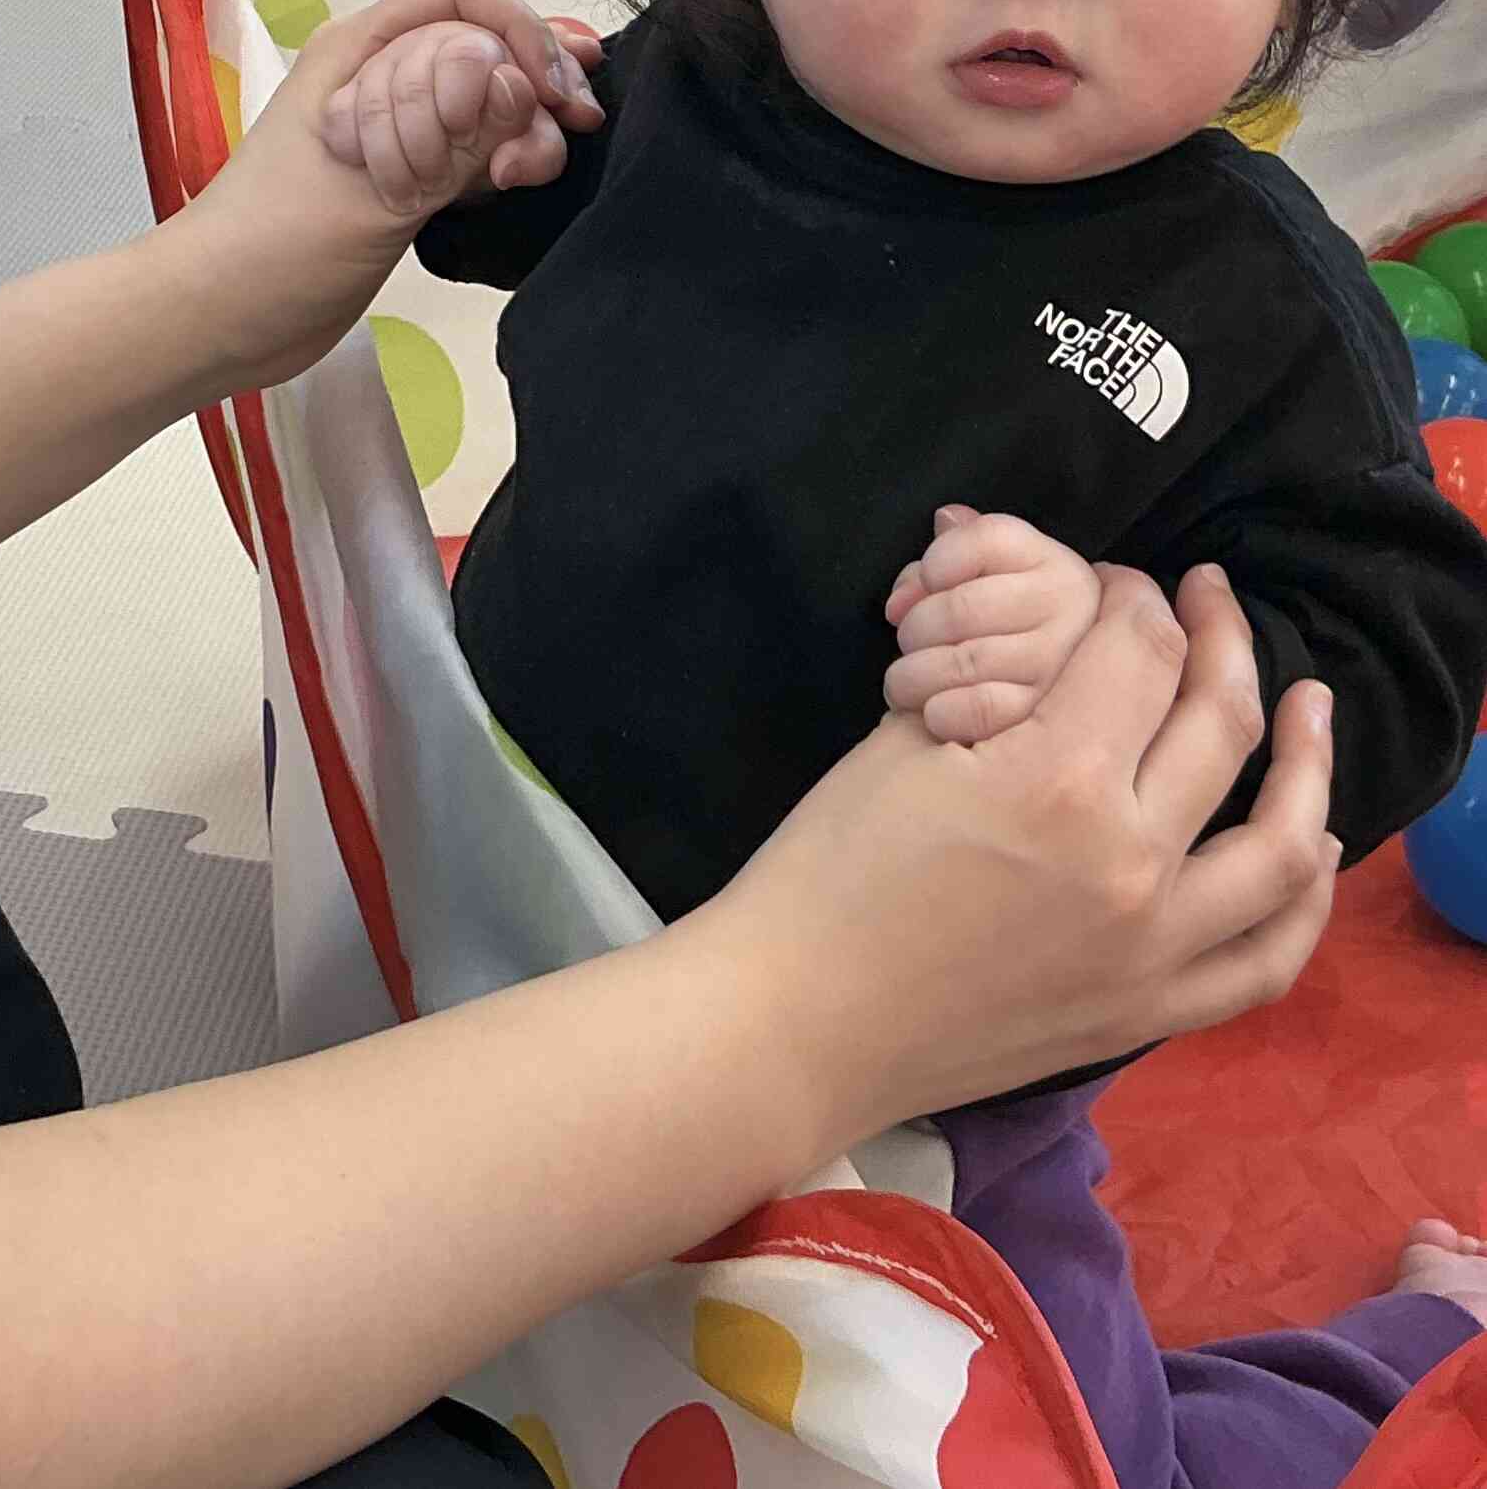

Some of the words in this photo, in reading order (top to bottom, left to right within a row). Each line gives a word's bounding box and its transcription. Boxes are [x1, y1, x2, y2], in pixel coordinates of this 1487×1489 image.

[1034, 302, 1146, 379] NORTH
[1100, 309, 1164, 358] THE
[1047, 342, 1128, 400] FACE
